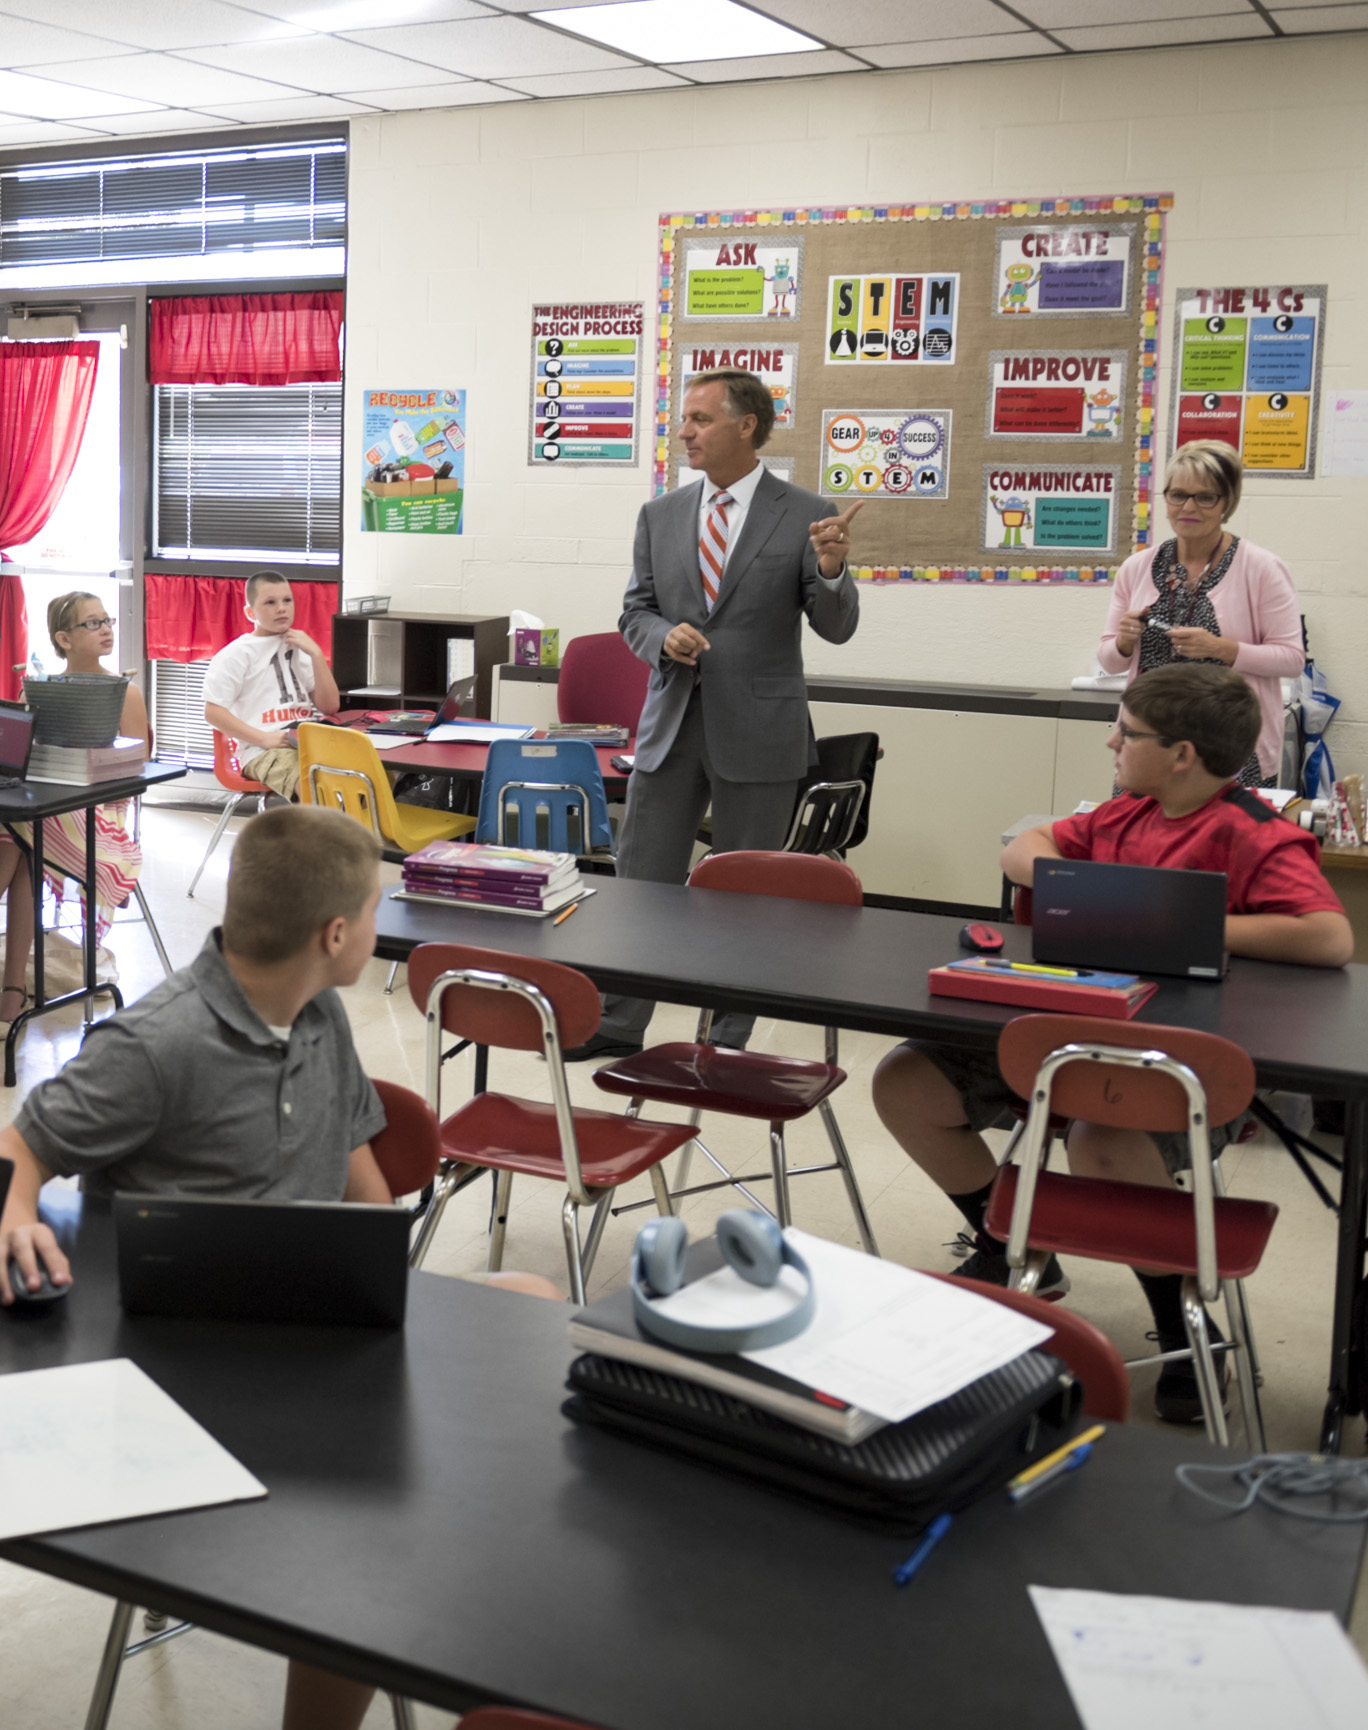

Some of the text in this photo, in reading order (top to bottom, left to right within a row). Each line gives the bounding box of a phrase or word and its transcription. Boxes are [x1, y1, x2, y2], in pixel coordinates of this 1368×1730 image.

[1021, 231, 1110, 258] CREATE
[715, 243, 758, 266] ASK
[1196, 287, 1304, 314] THE 4 Cs
[534, 303, 643, 320] THE ENGINEERING
[532, 320, 643, 337] DESIGN PROCESS
[692, 349, 784, 372] IMAGINE
[1003, 357, 1111, 381] IMPROVE
[369, 391, 438, 408] RECYCLE
[1182, 411, 1237, 419] COLLABORATION
[1258, 411, 1295, 419] CREATIVITY
[831, 427, 860, 440] GEAR
[884, 433, 891, 441] 4
[903, 432, 937, 443] SUCCESS
[888, 452, 898, 460] IN
[989, 471, 1113, 492] COMMUNICATE
[439, 865, 458, 873] Progress
